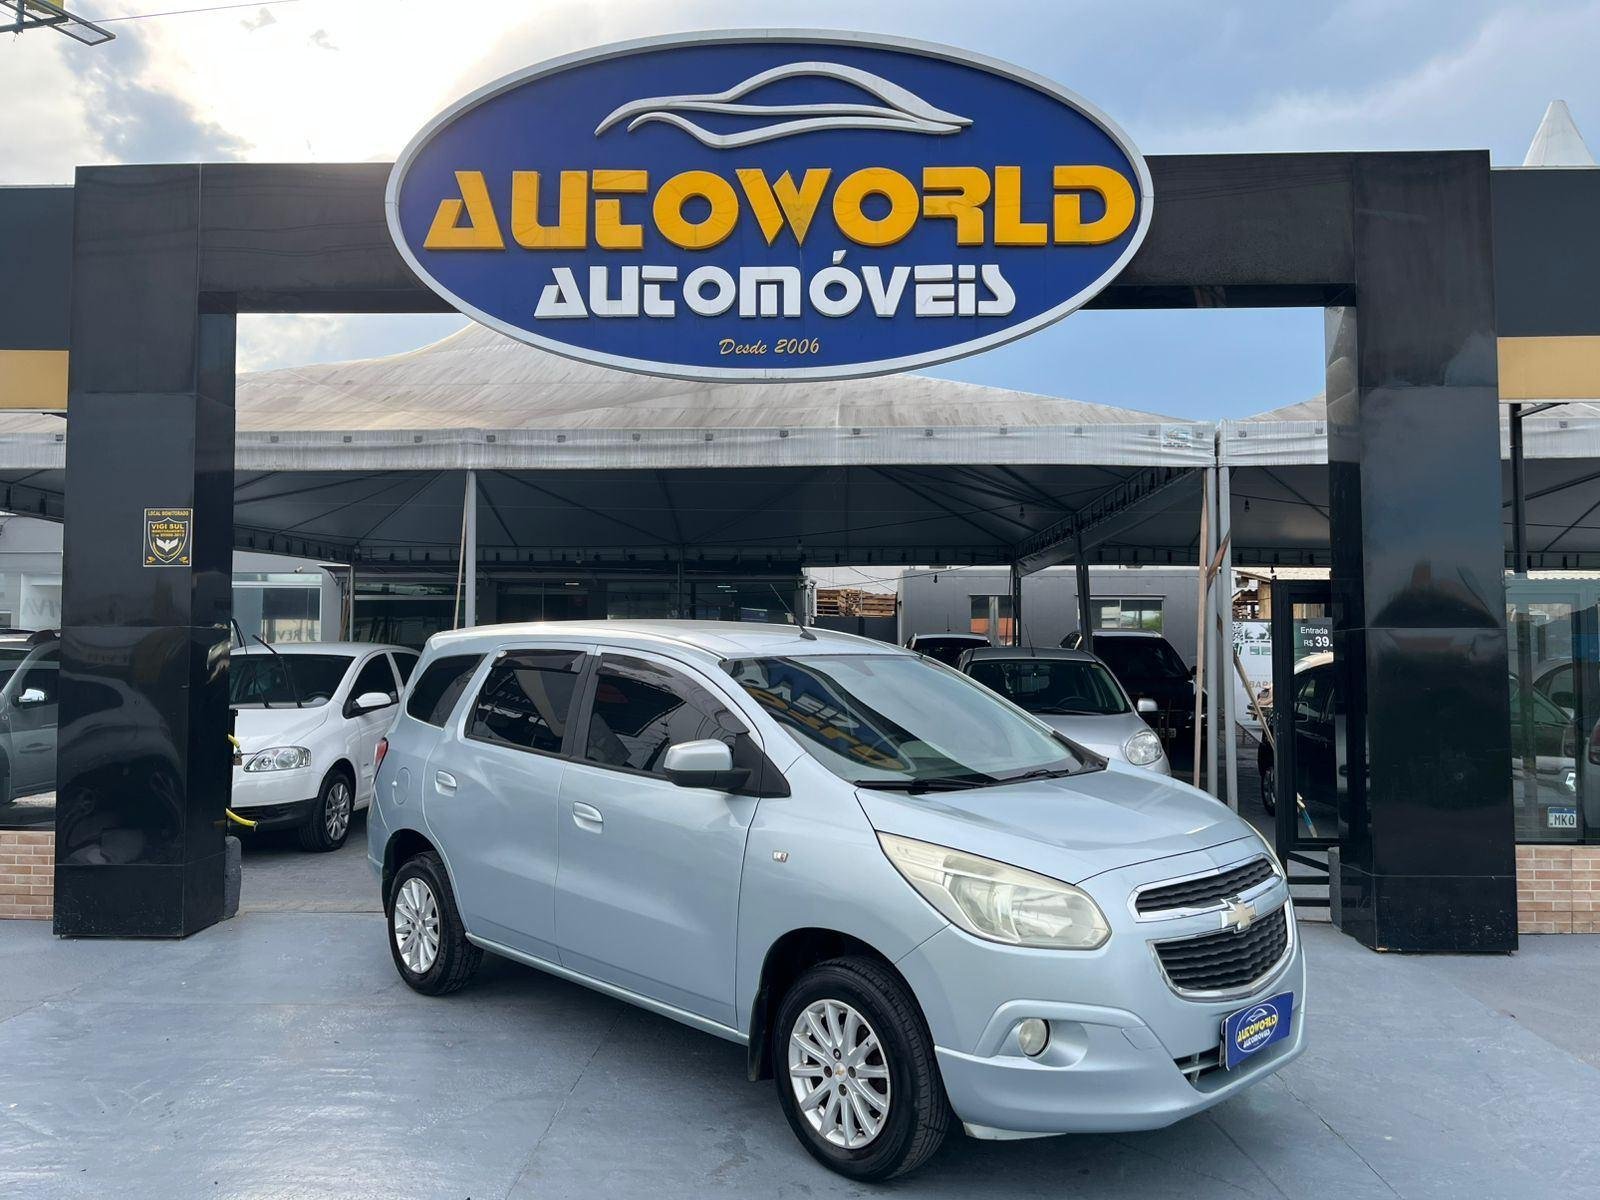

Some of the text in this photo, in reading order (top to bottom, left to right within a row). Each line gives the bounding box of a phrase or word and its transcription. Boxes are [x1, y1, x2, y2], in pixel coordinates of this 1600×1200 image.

[422, 165, 1136, 250] AUTOWORLD
[533, 249, 1017, 319] AUTOMÓVEIS
[719, 337, 819, 355] Desde 2006
[1300, 626, 1328, 634] Entrada
[1303, 639, 1314, 647] R$
[1237, 1014, 1277, 1042] AUTOWORLD
